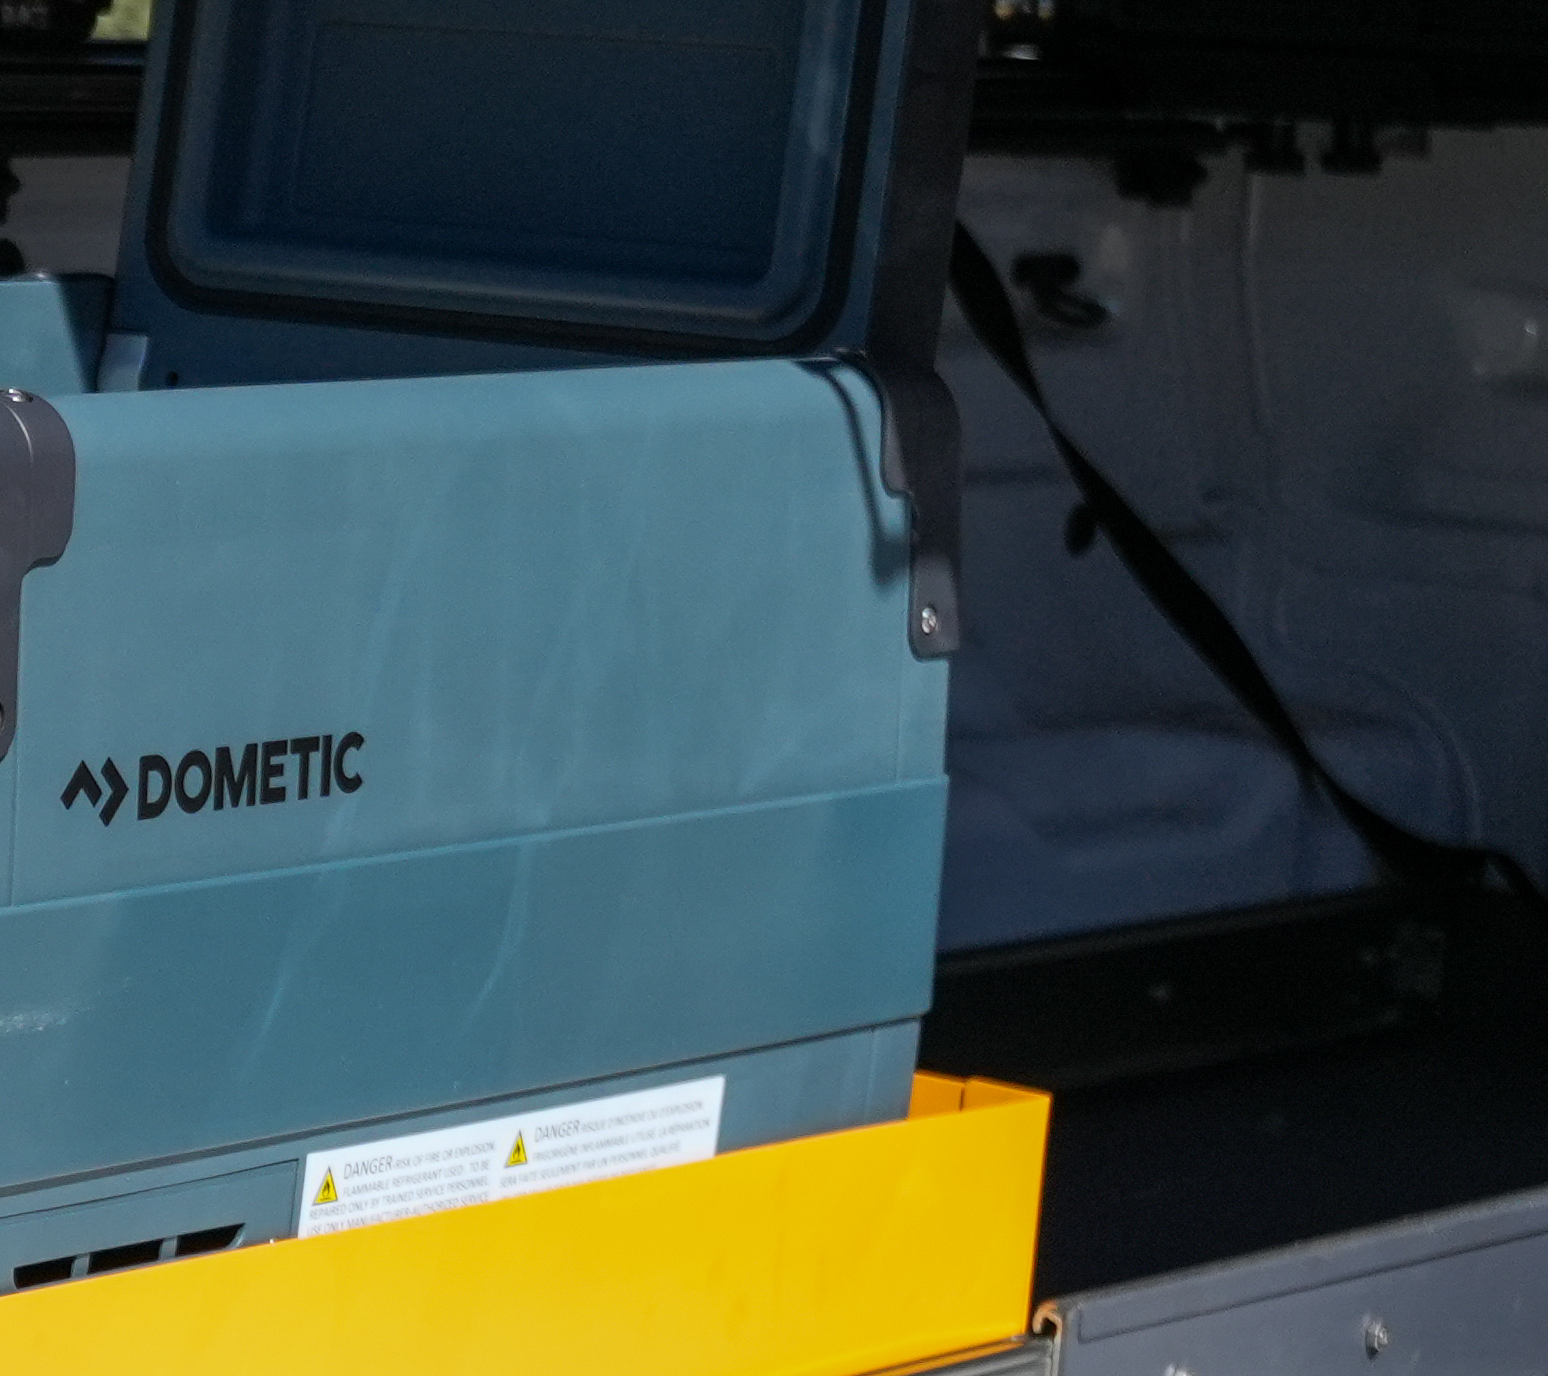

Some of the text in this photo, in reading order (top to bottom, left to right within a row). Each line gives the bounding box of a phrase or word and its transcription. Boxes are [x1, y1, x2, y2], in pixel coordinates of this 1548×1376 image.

[137, 731, 365, 821] DOMETIC
[535, 1119, 580, 1142] DANGER
[343, 1179, 390, 1197] FLAMMABLE
[392, 1169, 442, 1187] REFRIGERANT
[470, 1162, 480, 1173] TO
[480, 1160, 490, 1171] BE
[344, 1156, 393, 1179] DANGER
[412, 1155, 424, 1165] OF
[426, 1152, 440, 1163] FIRE
[442, 1149, 454, 1160] OR
[309, 1203, 347, 1219] REPAIRED
[348, 1199, 368, 1212] ONLY
[370, 1197, 380, 1208] BY
[382, 1190, 414, 1205] TRAINED
[416, 1185, 444, 1199] SERVICE
